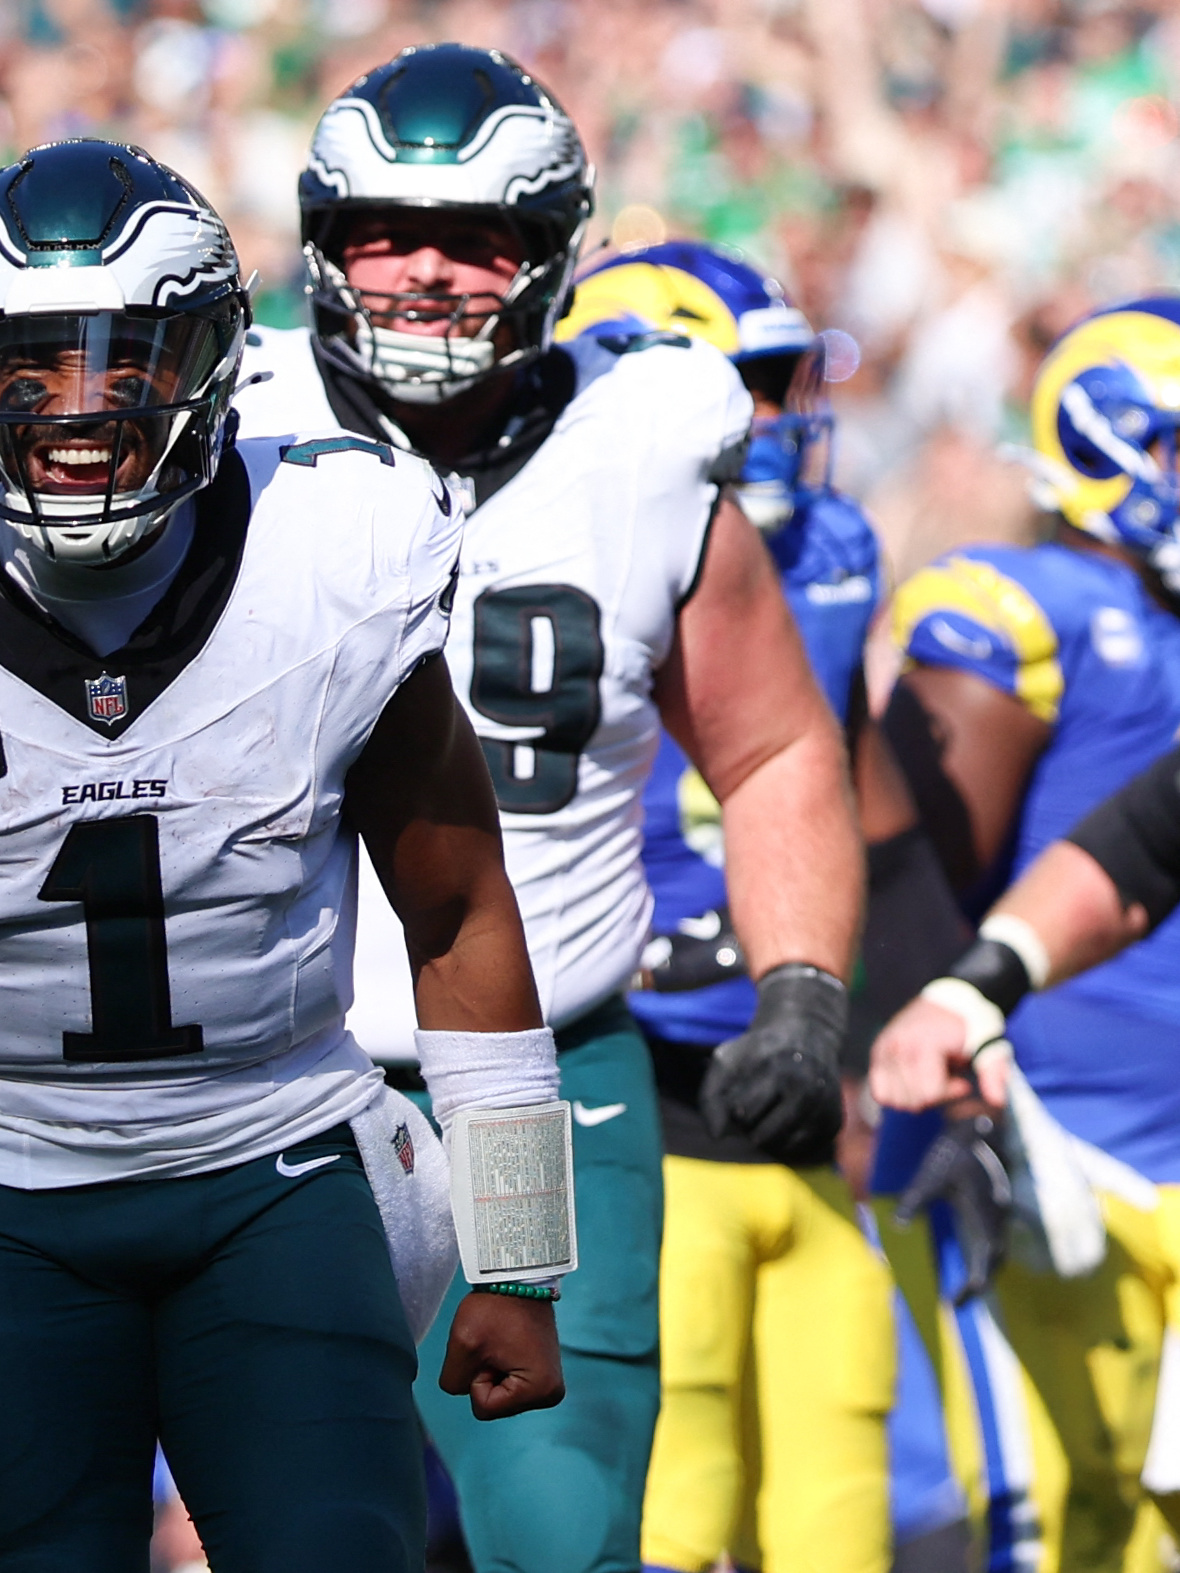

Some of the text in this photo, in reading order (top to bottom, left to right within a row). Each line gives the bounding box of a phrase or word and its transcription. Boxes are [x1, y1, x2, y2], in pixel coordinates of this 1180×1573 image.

[279, 436, 396, 467] 1
[93, 696, 124, 717] NFL
[61, 780, 168, 805] EAGLES
[37, 814, 204, 1062] 1
